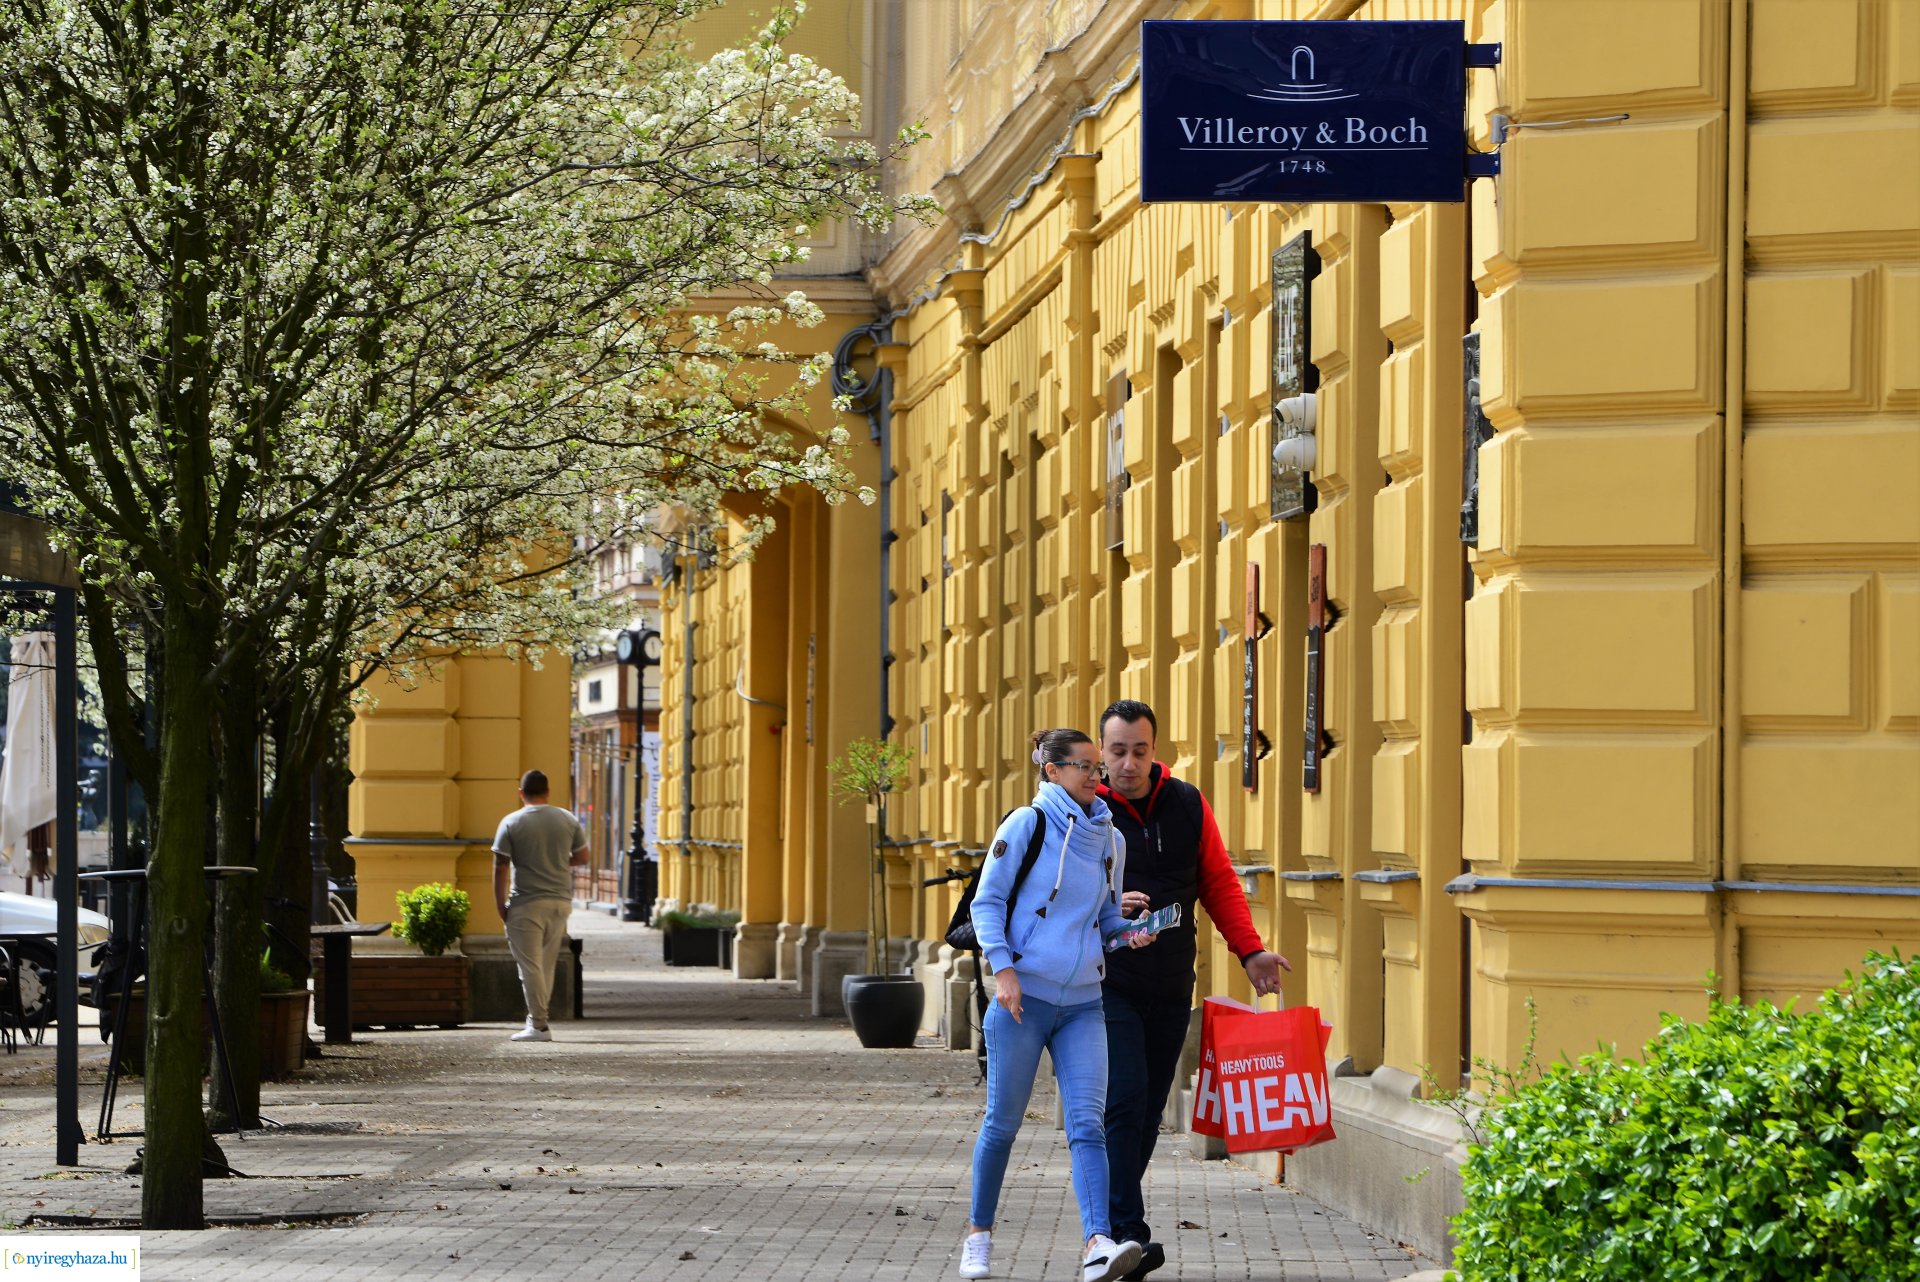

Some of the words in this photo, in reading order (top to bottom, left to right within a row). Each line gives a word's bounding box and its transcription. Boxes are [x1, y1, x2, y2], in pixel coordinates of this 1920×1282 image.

[1177, 117, 1310, 150] Villeroy
[1316, 121, 1337, 144] &
[1344, 116, 1428, 144] Boch
[1279, 160, 1327, 174] 1748
[1220, 1057, 1253, 1075] HEAVY
[1253, 1055, 1285, 1072] TOOLS
